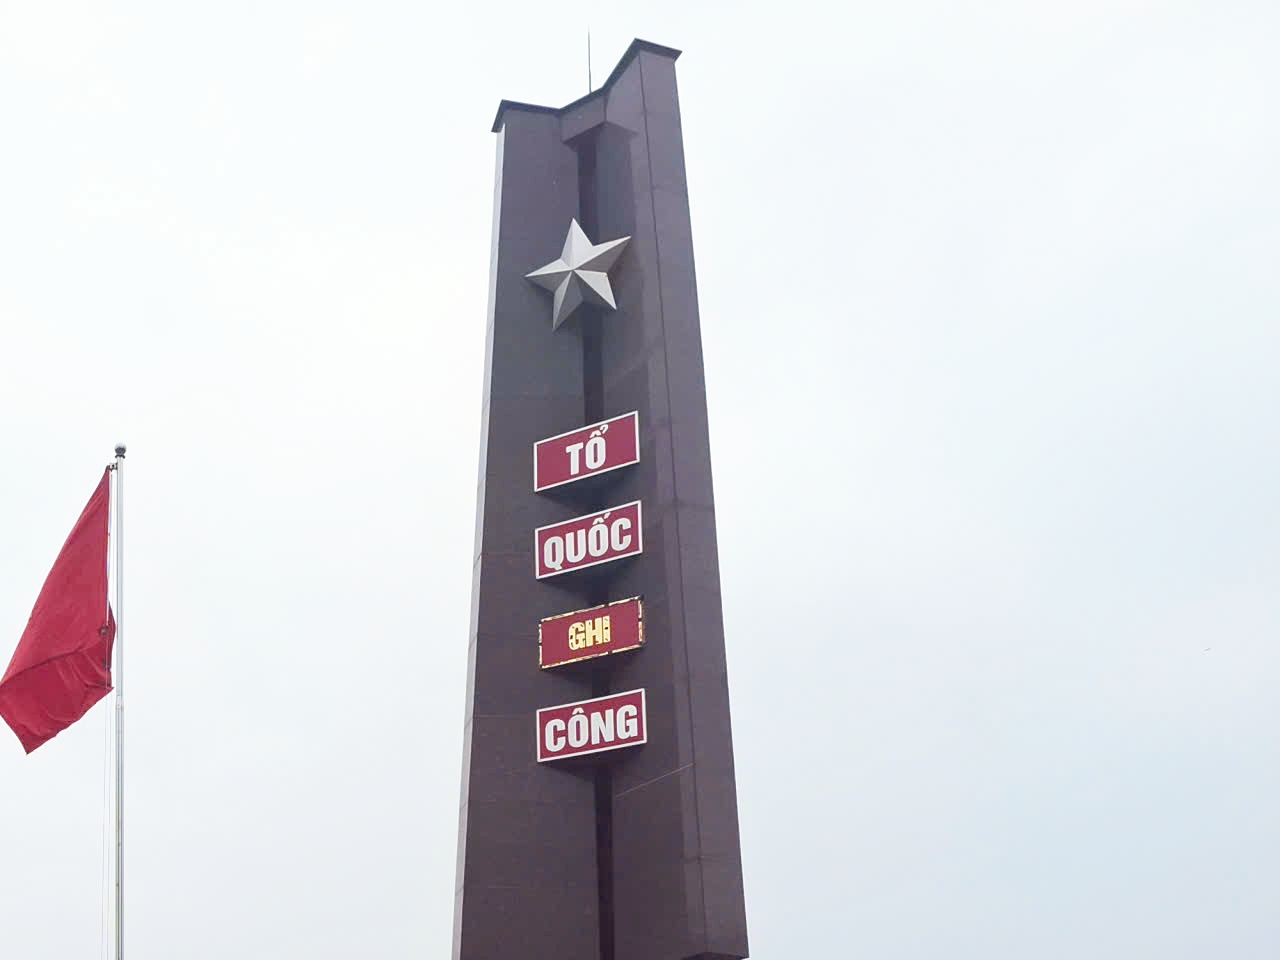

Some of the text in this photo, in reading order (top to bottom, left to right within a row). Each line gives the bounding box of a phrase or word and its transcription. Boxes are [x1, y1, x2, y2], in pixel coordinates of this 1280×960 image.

[565, 423, 609, 476] TỔ
[543, 511, 632, 571] QUỐC
[568, 615, 610, 650] GHI
[544, 704, 638, 752] CÔNG
